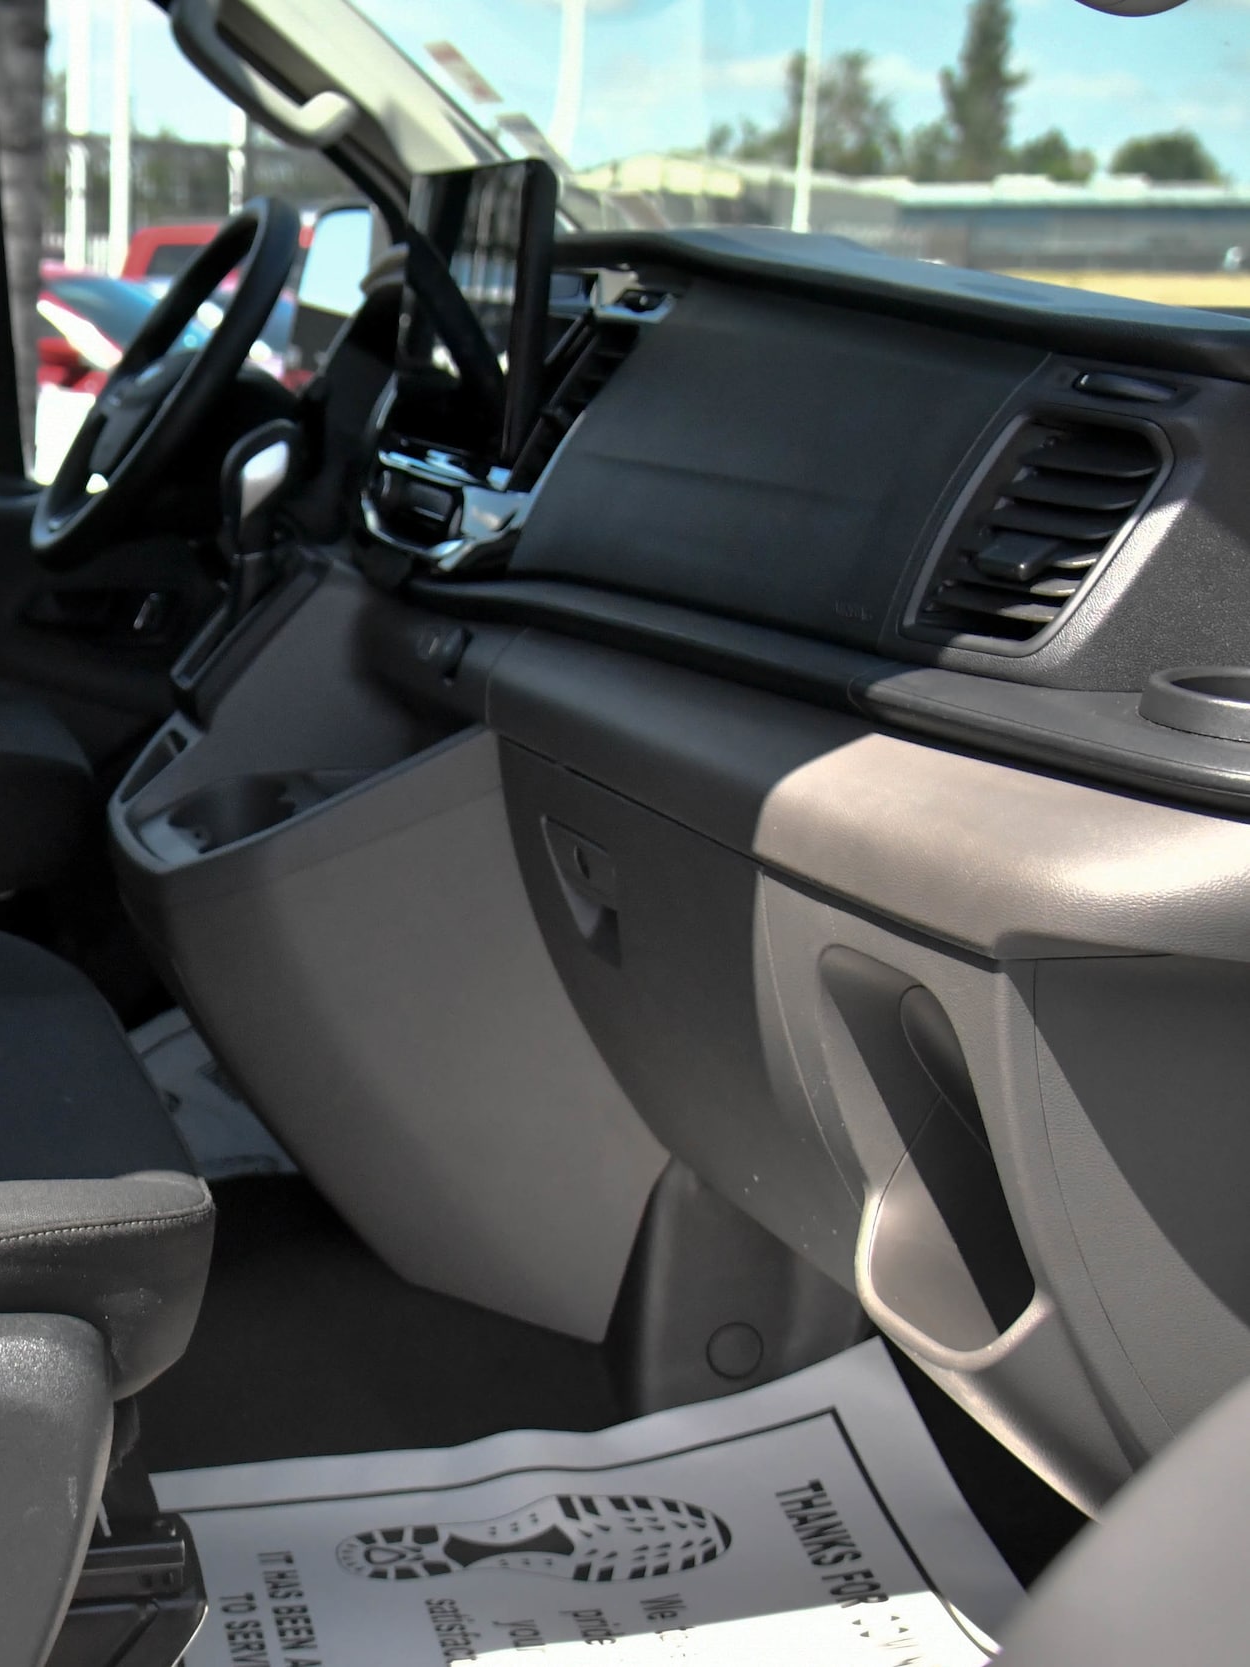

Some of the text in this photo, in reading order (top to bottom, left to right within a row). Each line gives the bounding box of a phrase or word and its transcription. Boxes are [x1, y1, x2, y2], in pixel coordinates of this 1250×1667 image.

[257, 1551, 293, 1565] IT
[775, 1478, 862, 1566] THANKS
[821, 1569, 889, 1608] FOR
[262, 1569, 304, 1599] HAS
[219, 1592, 257, 1613] TO
[639, 1593, 686, 1620] We
[272, 1604, 318, 1650] BEEN
[559, 1608, 625, 1645] pride
